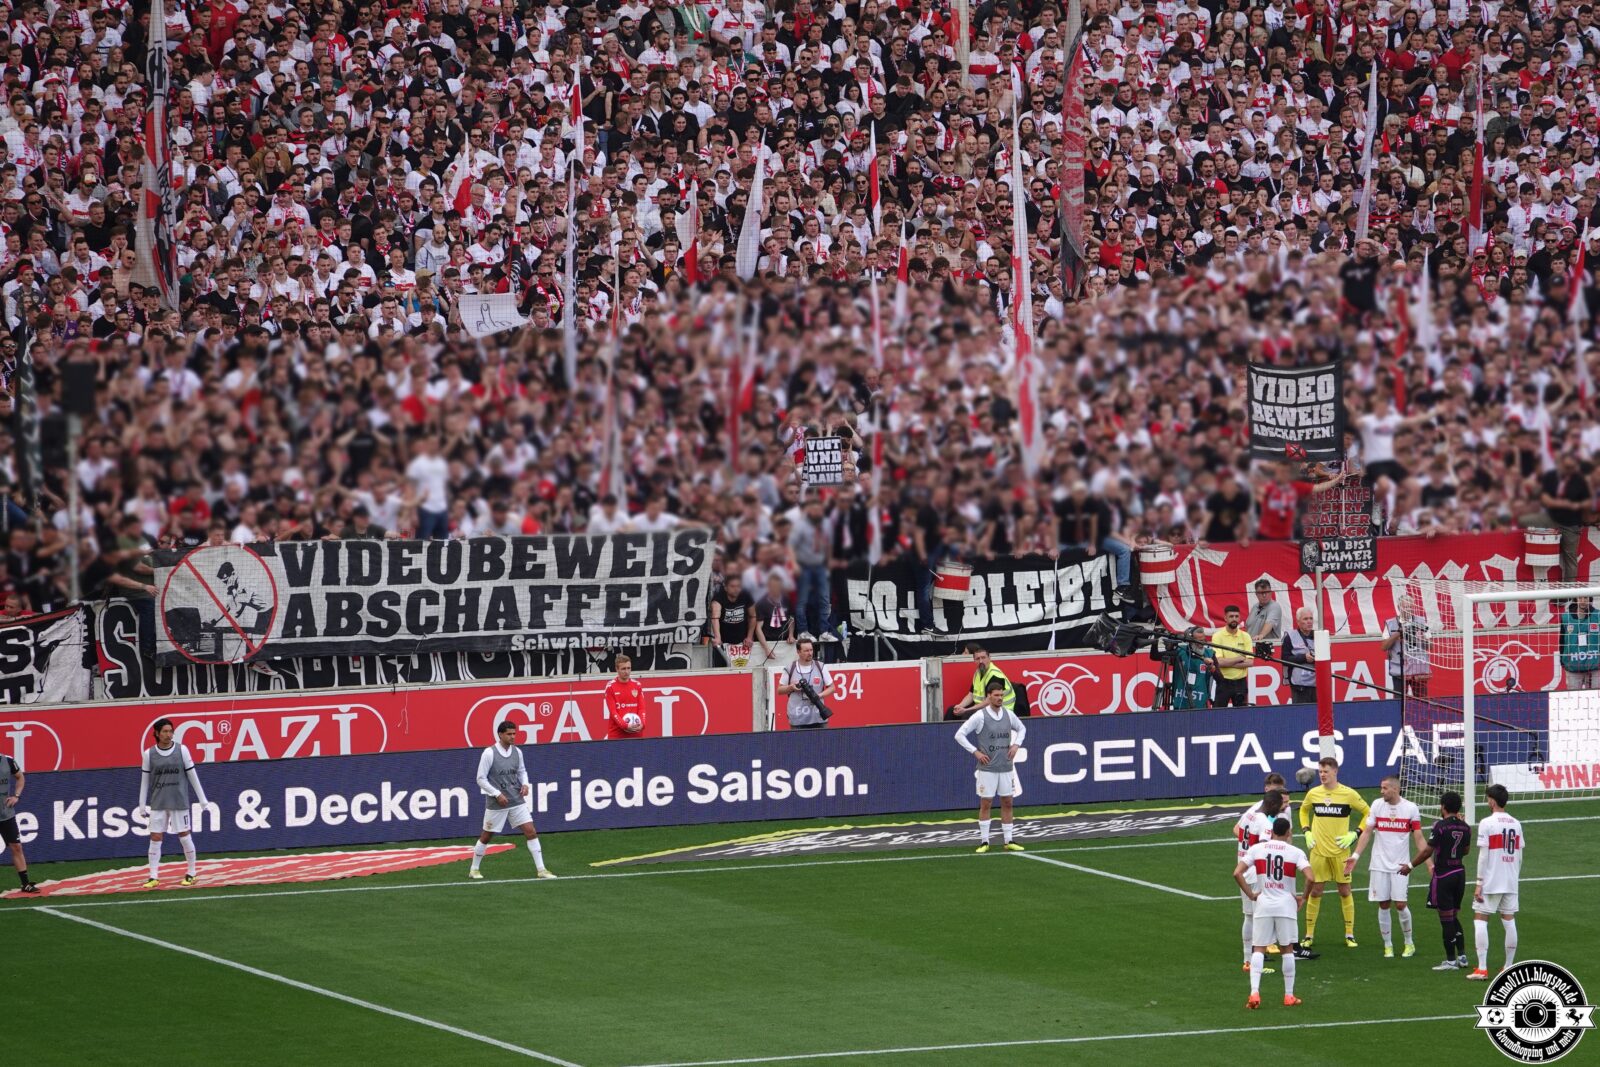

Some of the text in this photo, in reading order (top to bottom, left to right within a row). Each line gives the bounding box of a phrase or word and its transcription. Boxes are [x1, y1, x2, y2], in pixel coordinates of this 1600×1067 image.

[1250, 373, 1335, 405] VIDEO
[1251, 400, 1335, 427] BEWEIS
[807, 439, 841, 451] VOGT
[1253, 423, 1335, 441] ABSCHAFFEN!
[807, 450, 841, 464] UND
[809, 472, 842, 484] RAUS
[1321, 549, 1373, 562] IMMER
[1322, 539, 1373, 550] DU BIST
[279, 529, 707, 588] VIDEOBEWEIS
[1345, 560, 1374, 570] UNS!
[281, 578, 700, 639] ABSCHAFFEN!
[511, 625, 701, 652] Schwabensturm02
[833, 672, 864, 701] 34
[566, 767, 674, 822] jede
[687, 758, 869, 804] Saison.
[53, 796, 220, 841] Kissn
[237, 788, 272, 831] &
[285, 781, 469, 828] Decken
[1377, 821, 1408, 829] WINAMAX
[1451, 831, 1464, 859] 7
[1502, 828, 1516, 855] 16
[1266, 853, 1284, 881] 18
